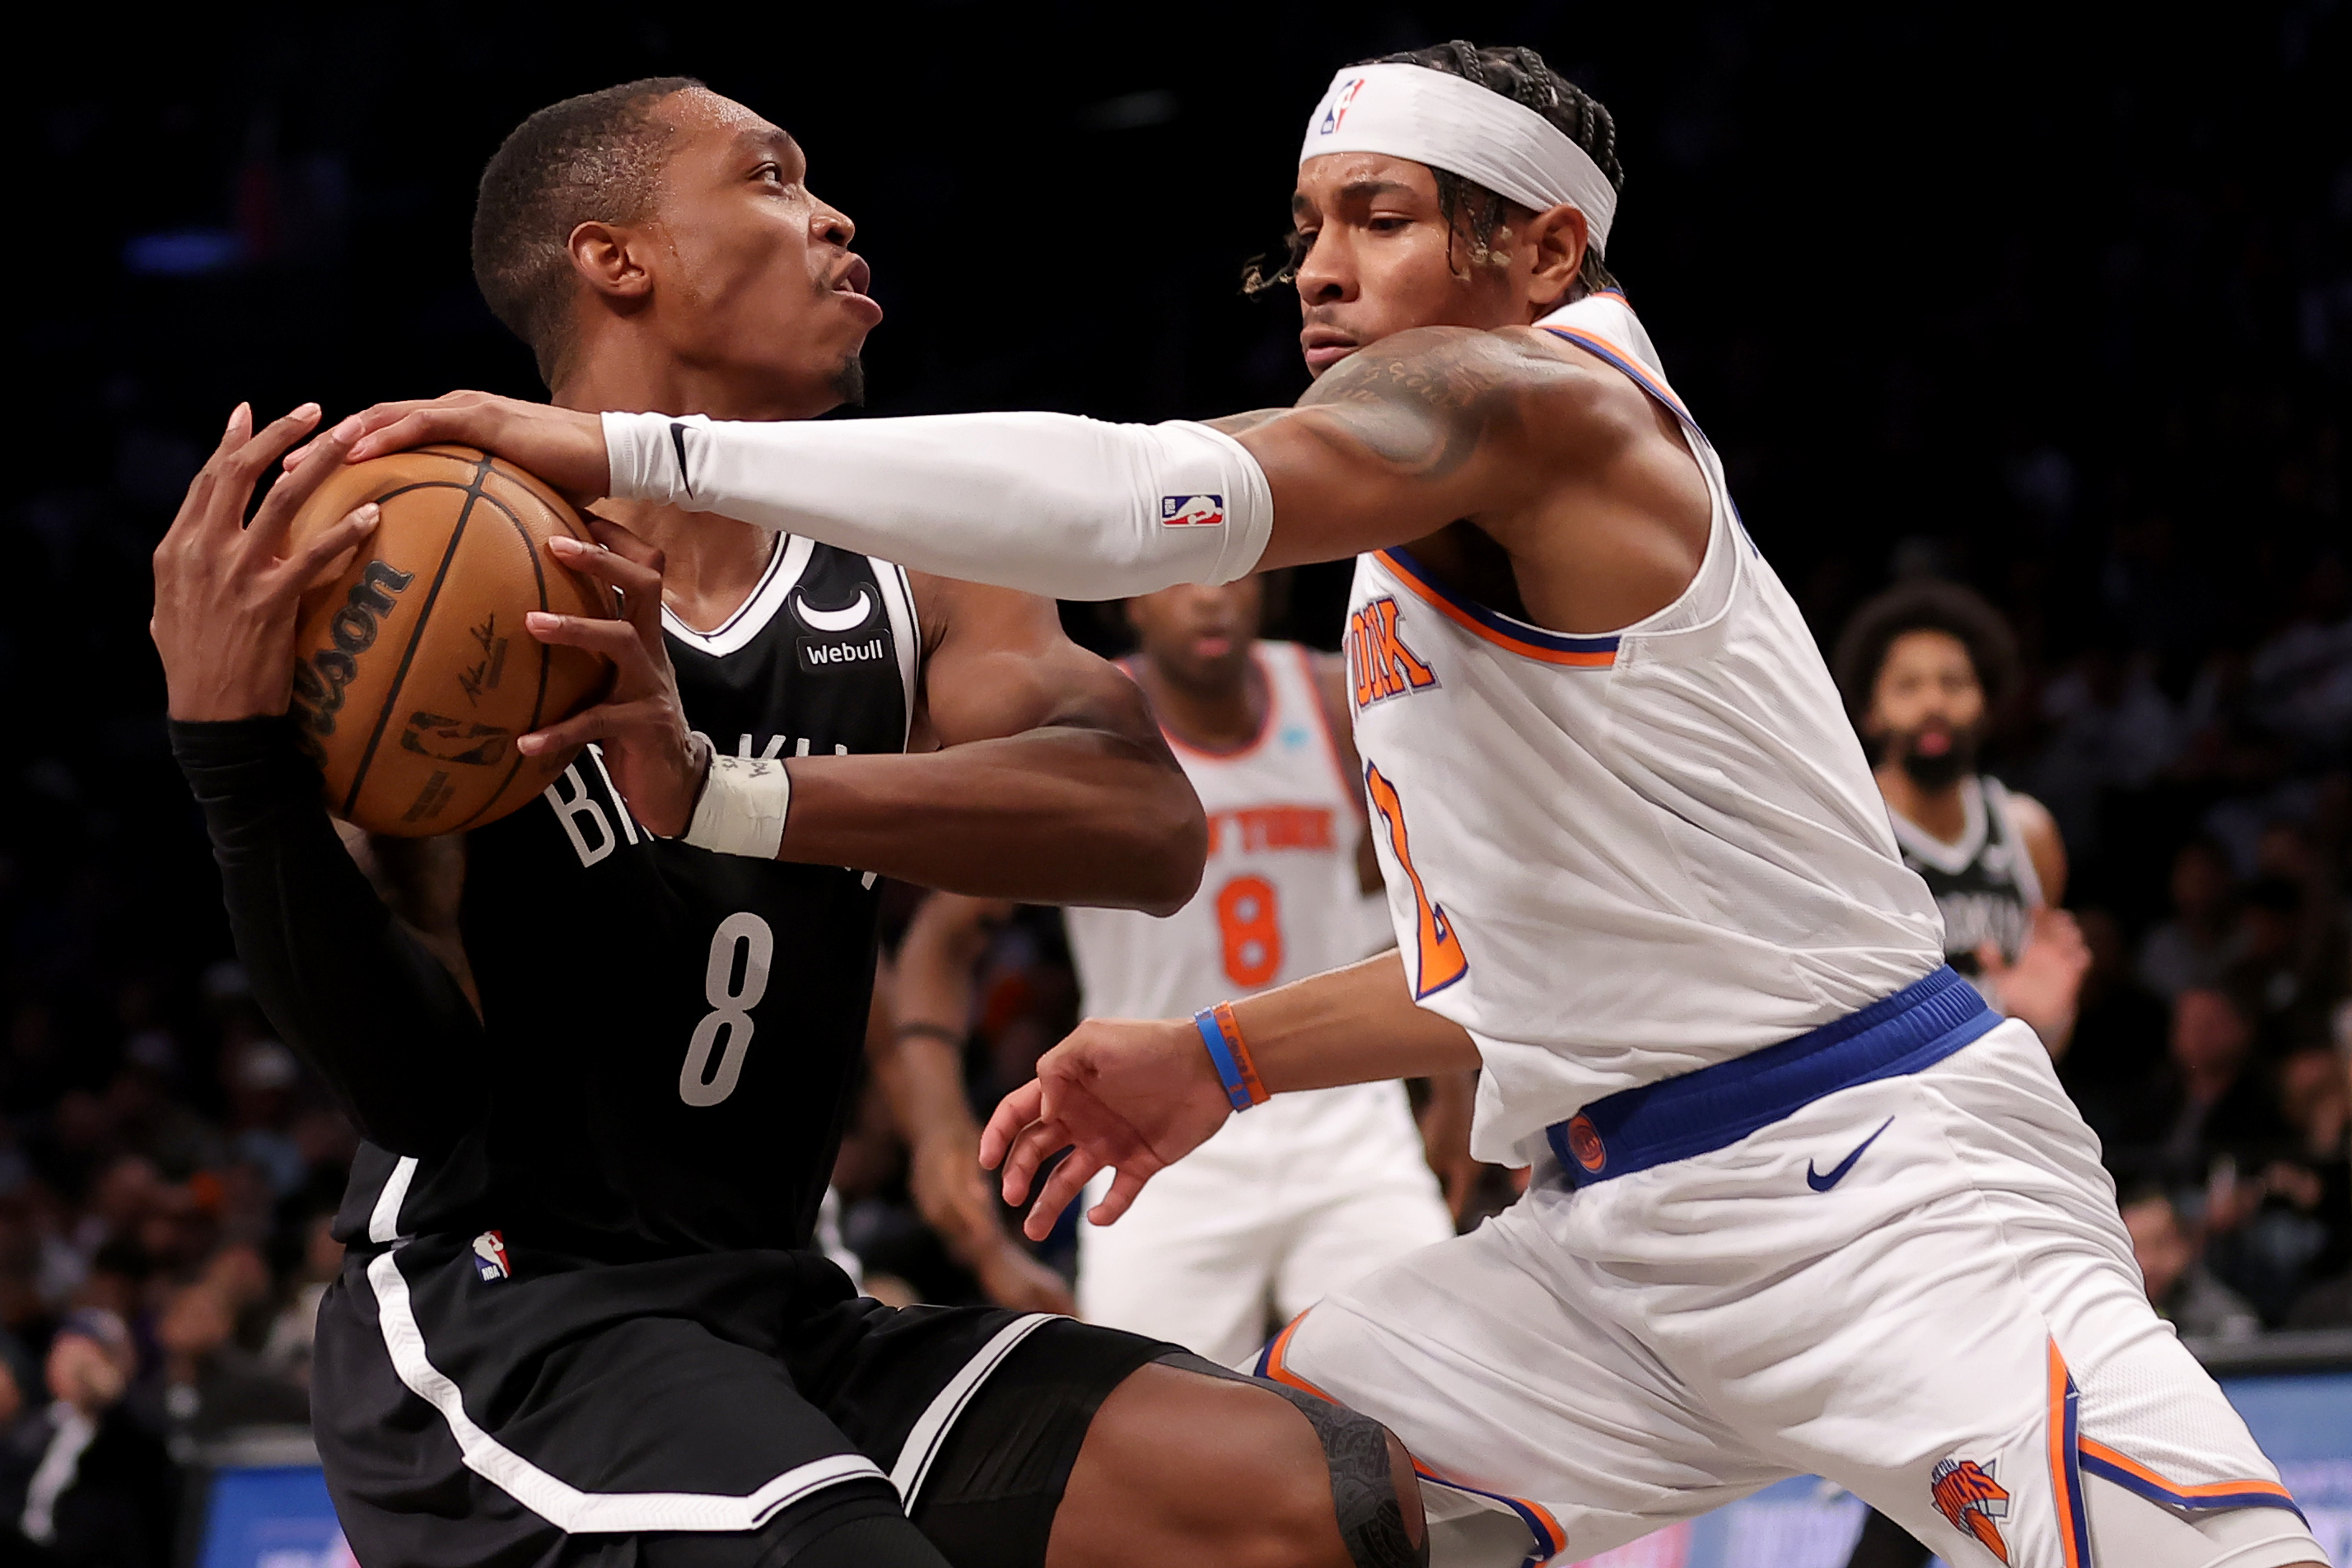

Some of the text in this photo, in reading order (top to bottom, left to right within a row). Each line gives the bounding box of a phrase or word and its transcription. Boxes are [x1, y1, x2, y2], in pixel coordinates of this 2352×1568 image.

[292, 559, 415, 771] ilson
[806, 638, 884, 665] Webull
[1345, 596, 1440, 715] ORK
[1215, 872, 1283, 987] 8
[1365, 757, 1470, 1002] 2
[679, 911, 774, 1108] 8
[481, 1264, 502, 1281] NBA
